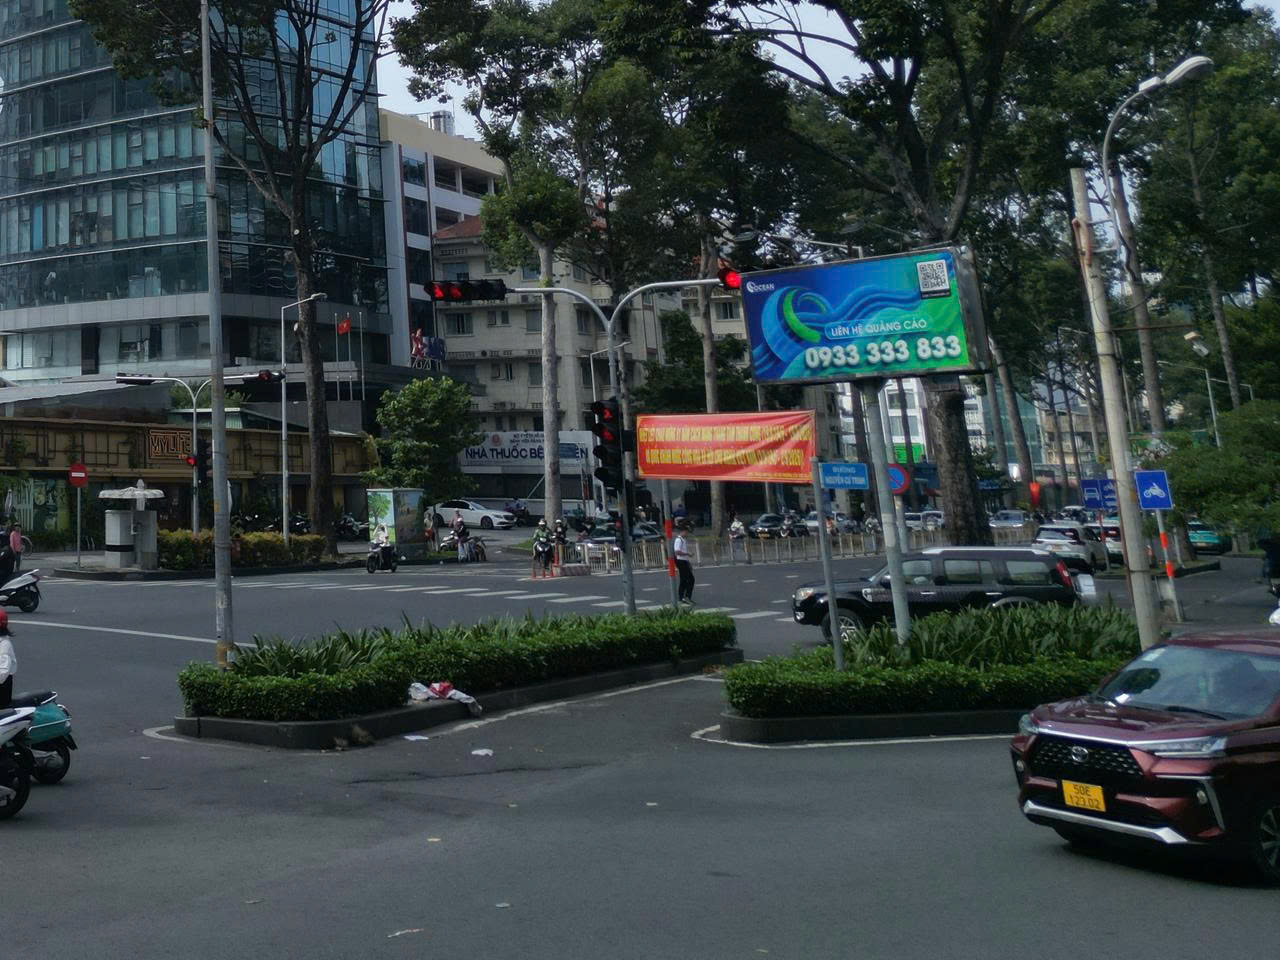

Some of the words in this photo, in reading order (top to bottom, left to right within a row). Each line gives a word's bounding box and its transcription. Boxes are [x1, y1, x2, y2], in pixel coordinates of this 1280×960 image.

[805, 344, 860, 368] 0933
[866, 339, 910, 364] 333
[917, 335, 961, 360] 833
[489, 444, 528, 459] THUỐC
